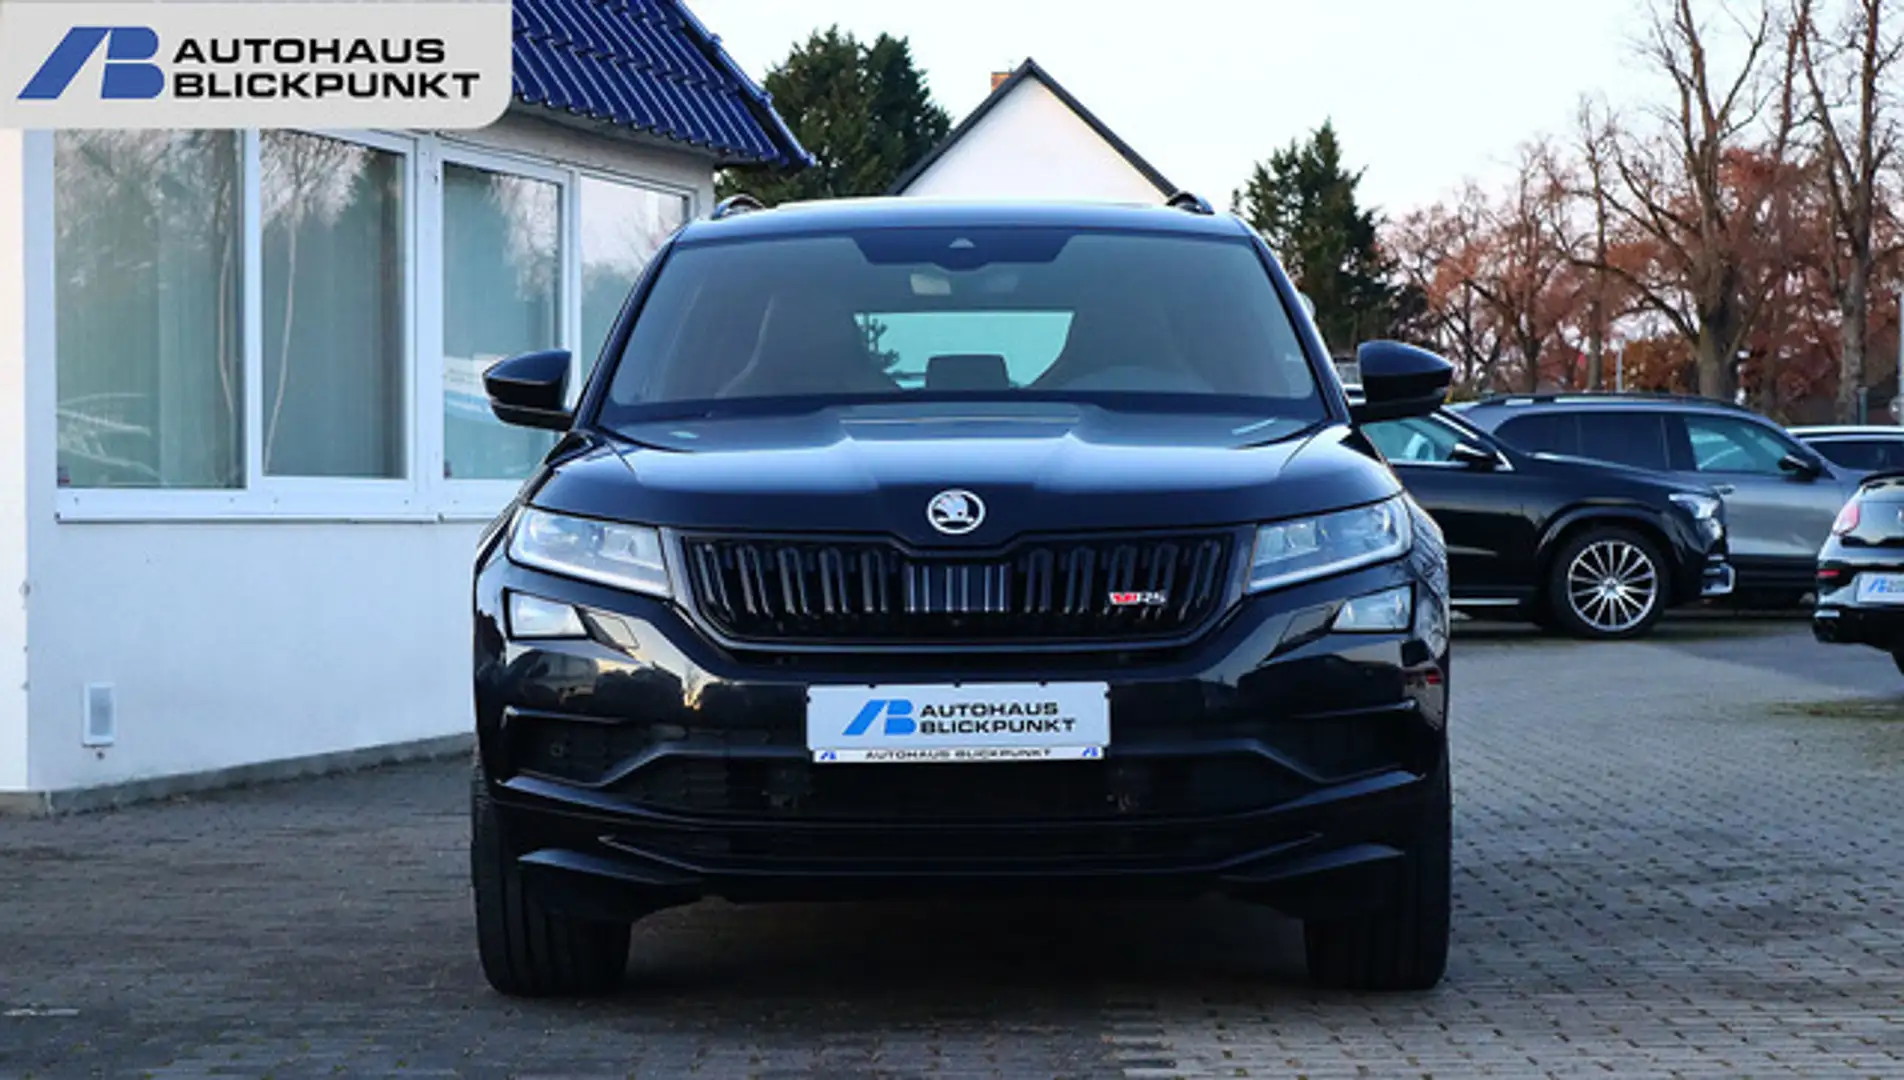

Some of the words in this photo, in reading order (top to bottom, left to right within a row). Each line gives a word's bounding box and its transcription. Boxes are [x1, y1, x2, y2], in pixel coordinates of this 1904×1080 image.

[919, 701, 1059, 719] AUTOHAUS
[919, 718, 1077, 734] BLICKPUNKT
[865, 750, 950, 760] AUTOHAUS
